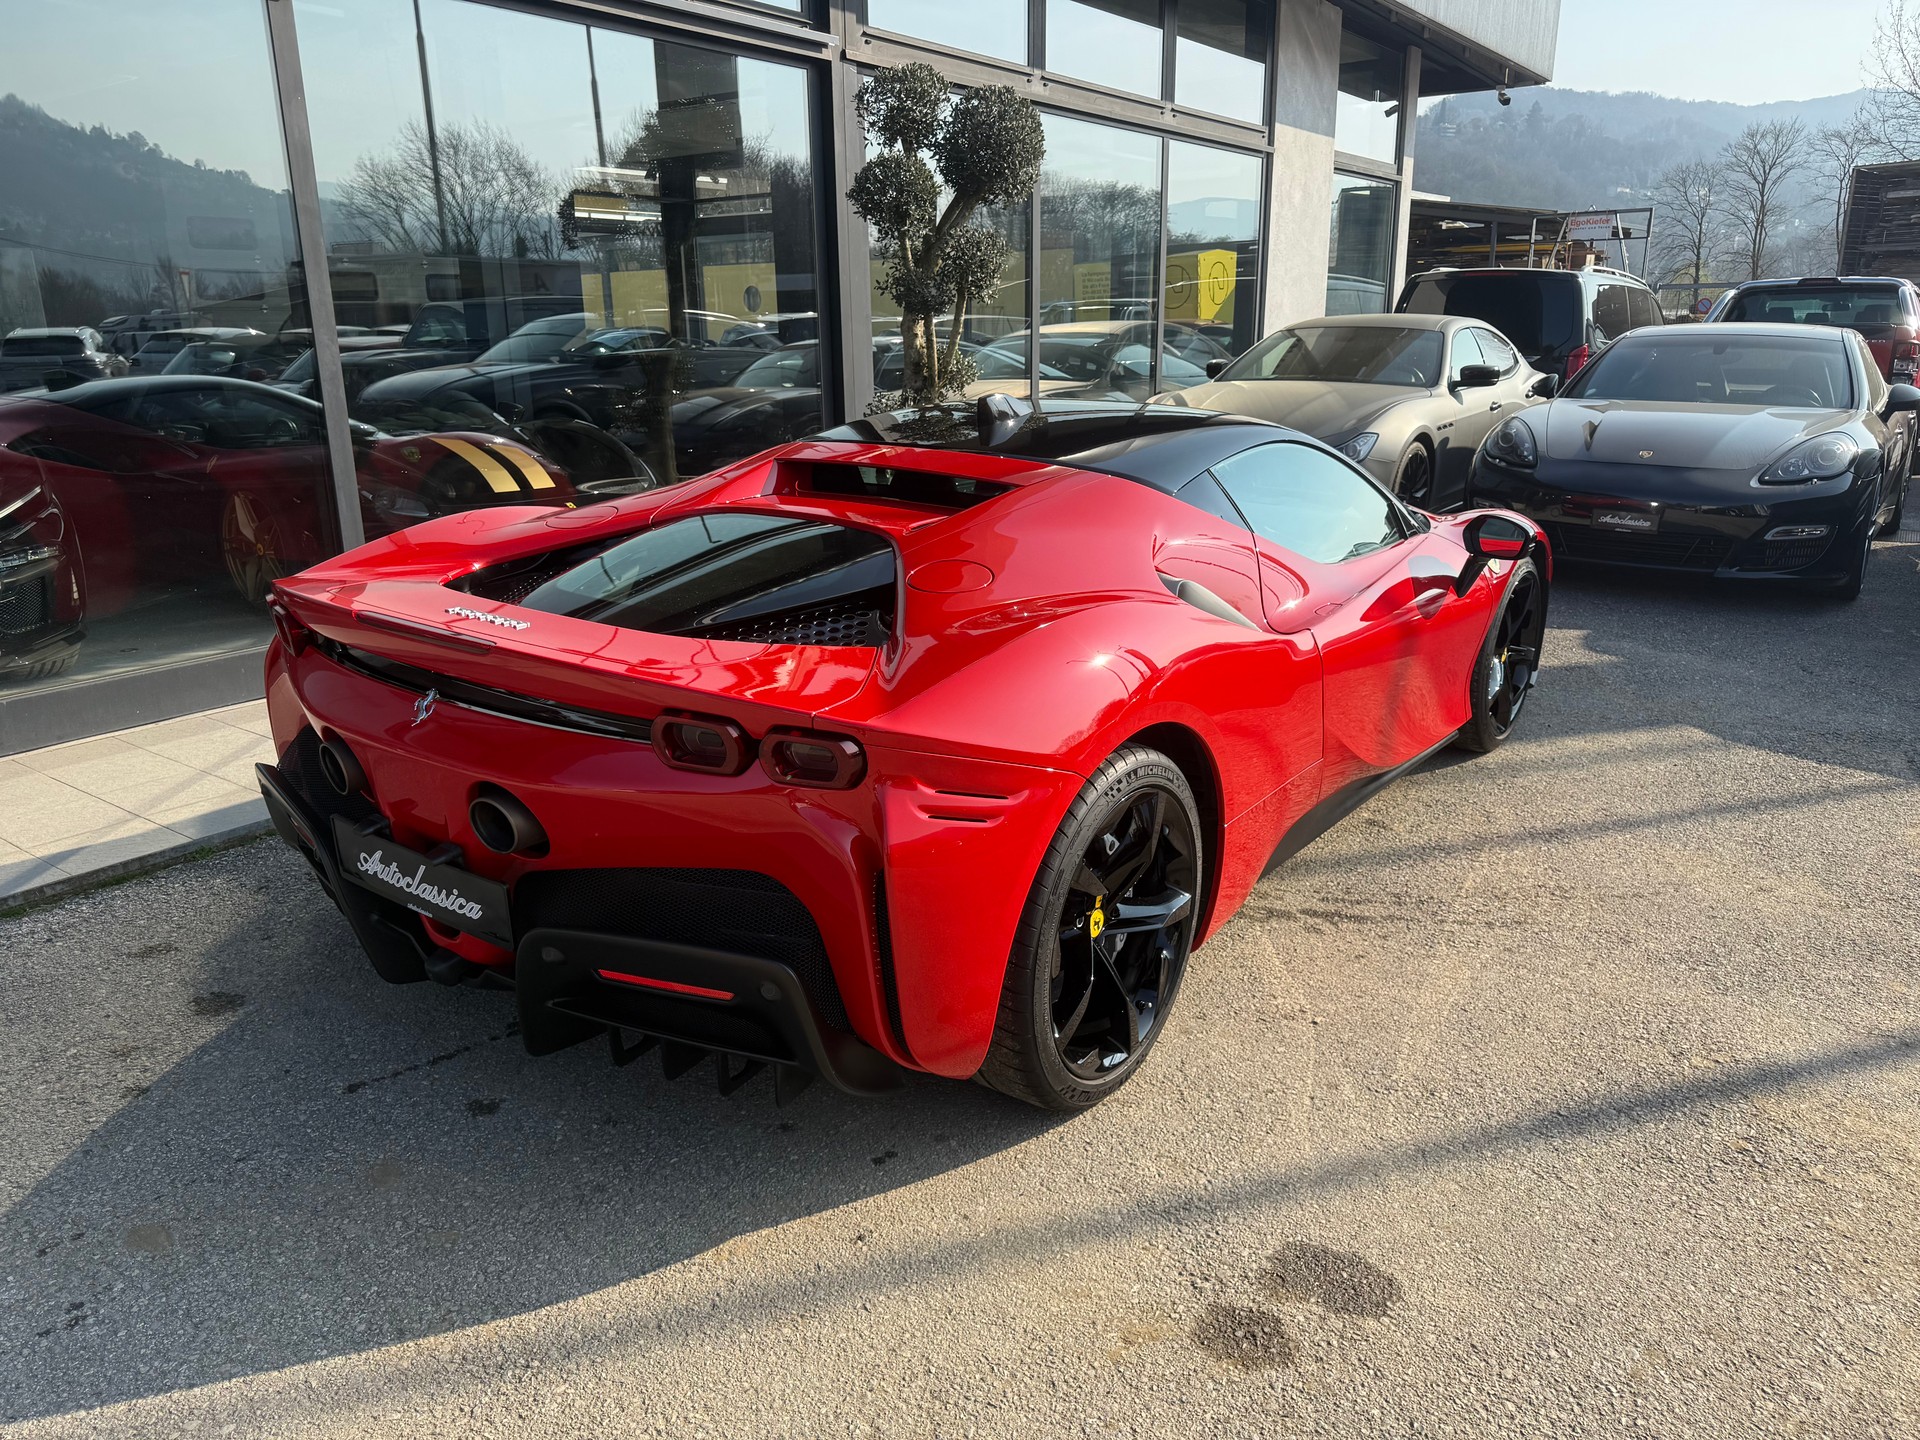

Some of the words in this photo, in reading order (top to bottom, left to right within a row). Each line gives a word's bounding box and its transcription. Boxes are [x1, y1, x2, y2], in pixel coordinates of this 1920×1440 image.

[1570, 217, 1611, 228] EgoKiefer
[1598, 514, 1652, 527] Autoclassica
[1136, 765, 1174, 780] MICHELIN
[357, 850, 483, 920] Autoclassica
